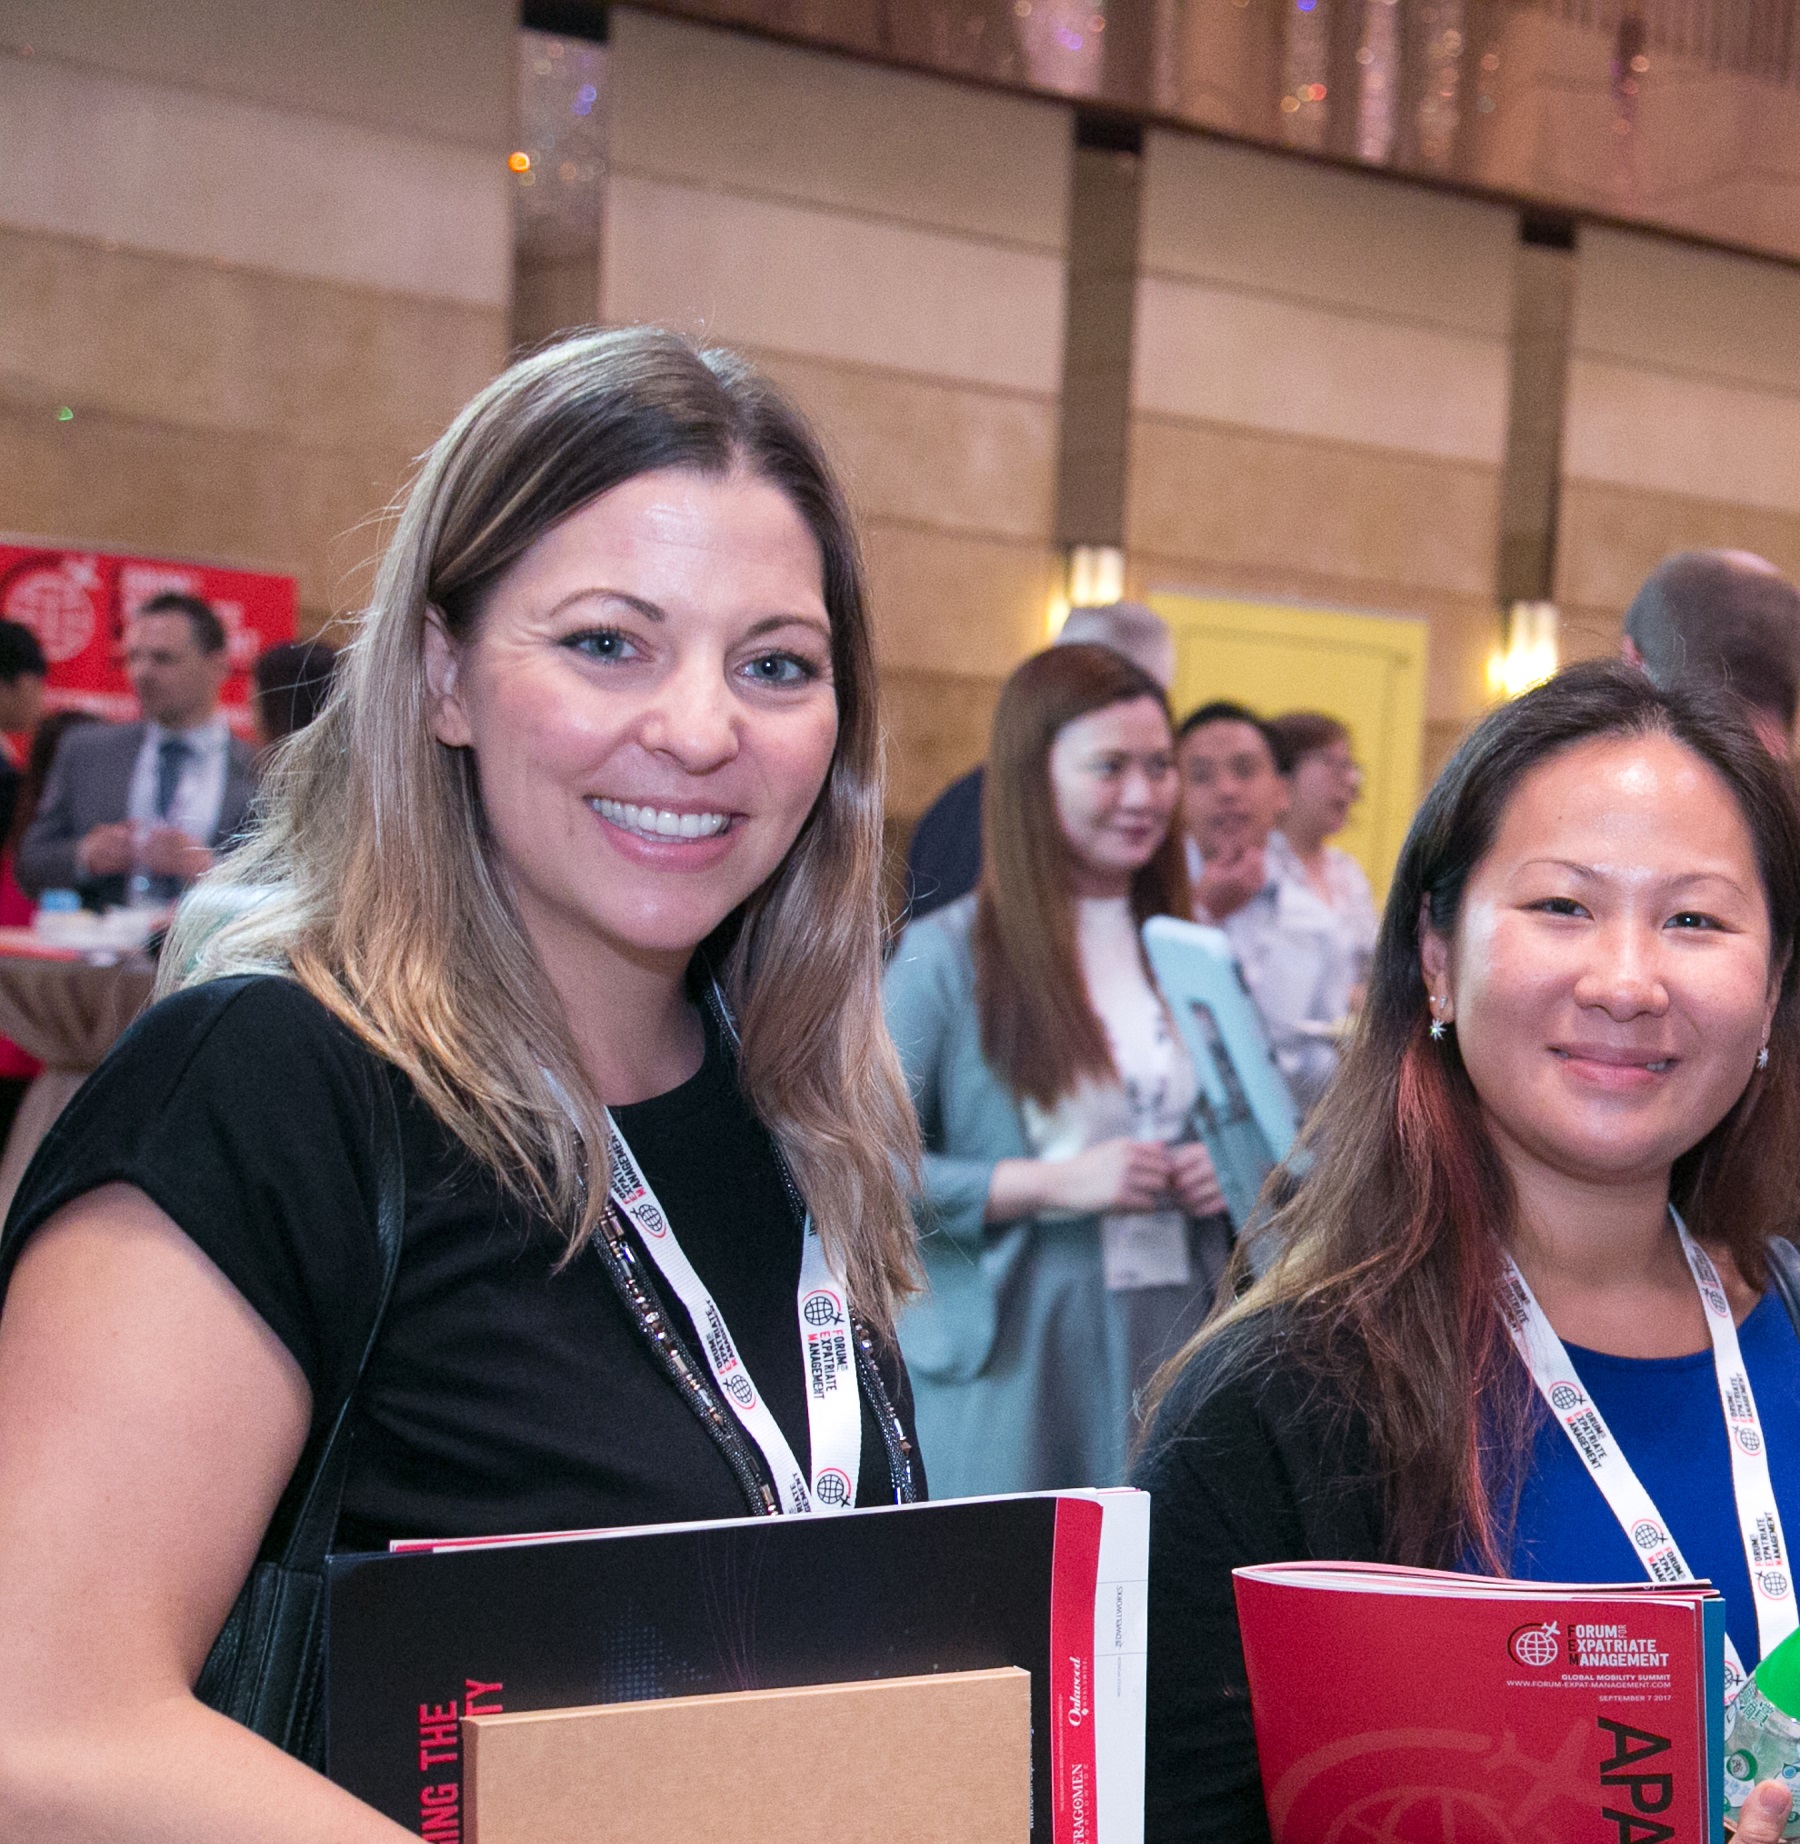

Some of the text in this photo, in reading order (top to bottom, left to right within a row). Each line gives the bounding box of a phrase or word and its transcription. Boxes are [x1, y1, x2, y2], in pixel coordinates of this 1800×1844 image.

[706, 1309, 732, 1371] EXPATRIATE
[708, 1338, 725, 1375] FORUM
[820, 1331, 837, 1391] EXPATRIATE
[832, 1329, 847, 1366] FORUM
[807, 1333, 825, 1399] MANAGEMENT
[1566, 1416, 1602, 1469] MANAGEMENT
[1574, 1411, 1607, 1459] EXPATRIATE
[1583, 1407, 1603, 1434] FORUM
[1664, 1547, 1683, 1575] FORUM
[1756, 1518, 1774, 1566] EXPATRIATE
[1764, 1511, 1782, 1566] MANAGEMENT
[1567, 1624, 1617, 1639] FORUM
[1567, 1639, 1657, 1653] EXPATRIATE
[1569, 1653, 1669, 1667] MANAGEMENT
[465, 1679, 503, 1717] TY
[1068, 1656, 1082, 1727] Oakwood
[419, 1700, 459, 1844] ING THE
